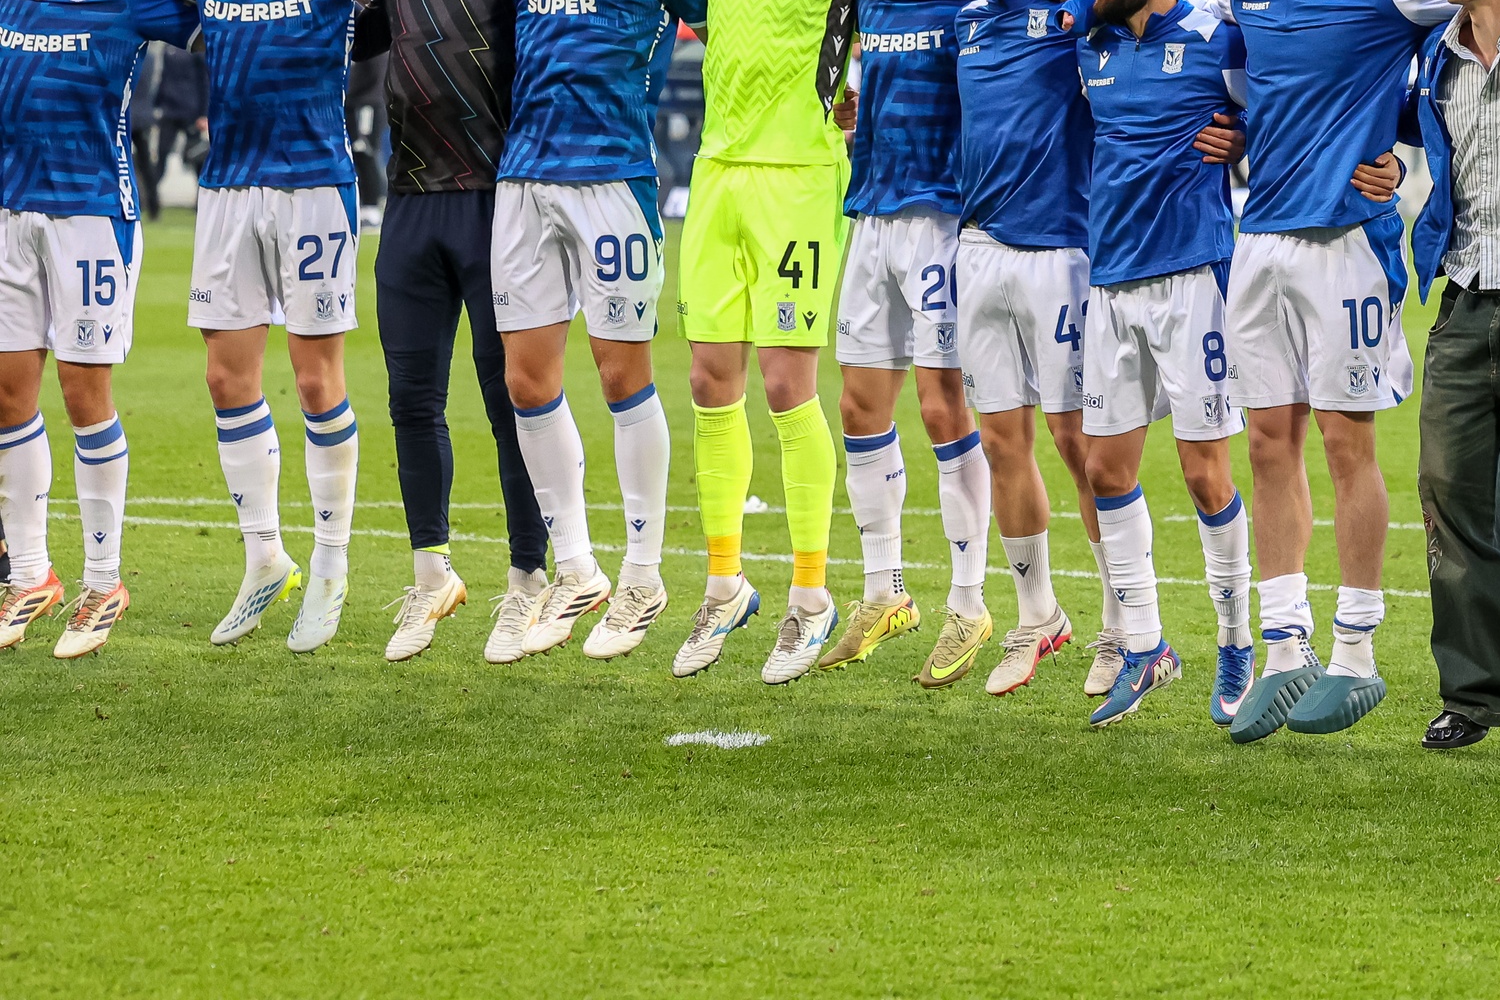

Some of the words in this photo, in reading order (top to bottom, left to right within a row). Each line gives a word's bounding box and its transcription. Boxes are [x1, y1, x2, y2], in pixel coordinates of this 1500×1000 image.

[1242, 1, 1271, 11] SUPERBET
[1087, 77, 1115, 87] SUPERBET
[297, 231, 347, 281] 27
[594, 233, 649, 283] 90
[777, 240, 820, 291] 41
[76, 260, 116, 307] 15
[1054, 299, 1089, 352] 4
[1342, 296, 1383, 350] 10
[1202, 331, 1227, 382] 8
